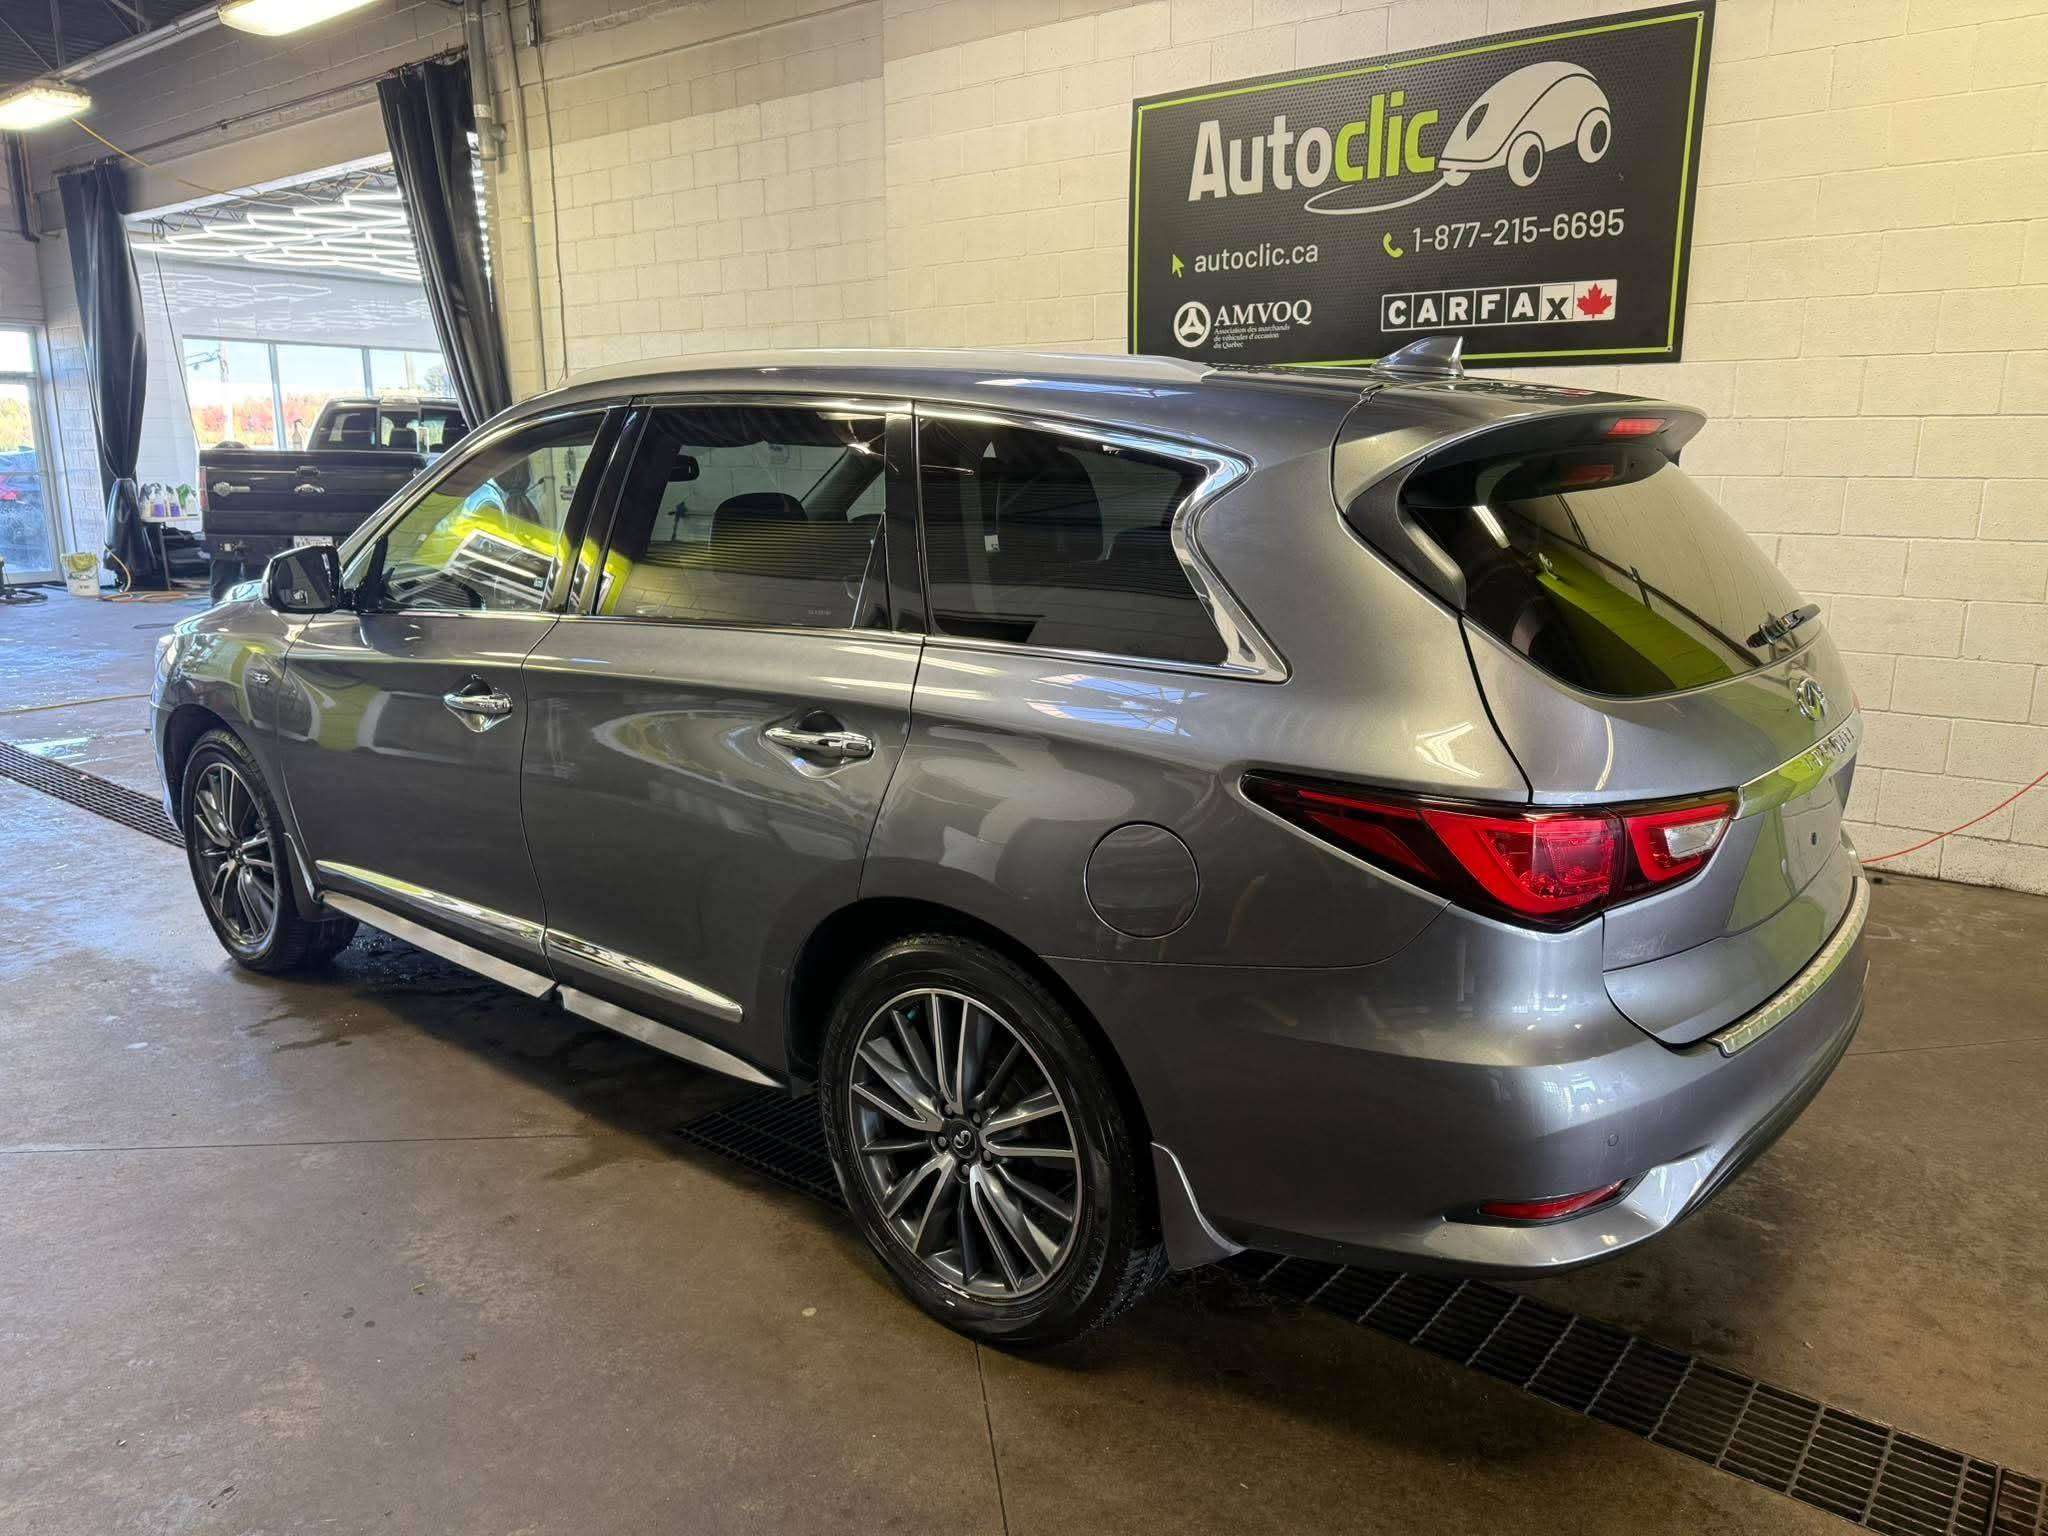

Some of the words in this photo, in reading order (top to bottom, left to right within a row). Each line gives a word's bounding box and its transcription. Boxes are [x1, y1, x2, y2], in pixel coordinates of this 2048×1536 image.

[1188, 91, 1439, 202] Autoclic
[1413, 208, 1625, 252] 1-877-215-6695
[1195, 243, 1318, 272] autoclic.ca
[1214, 300, 1312, 326] AMVOQ
[1387, 291, 1569, 325] CARFAX
